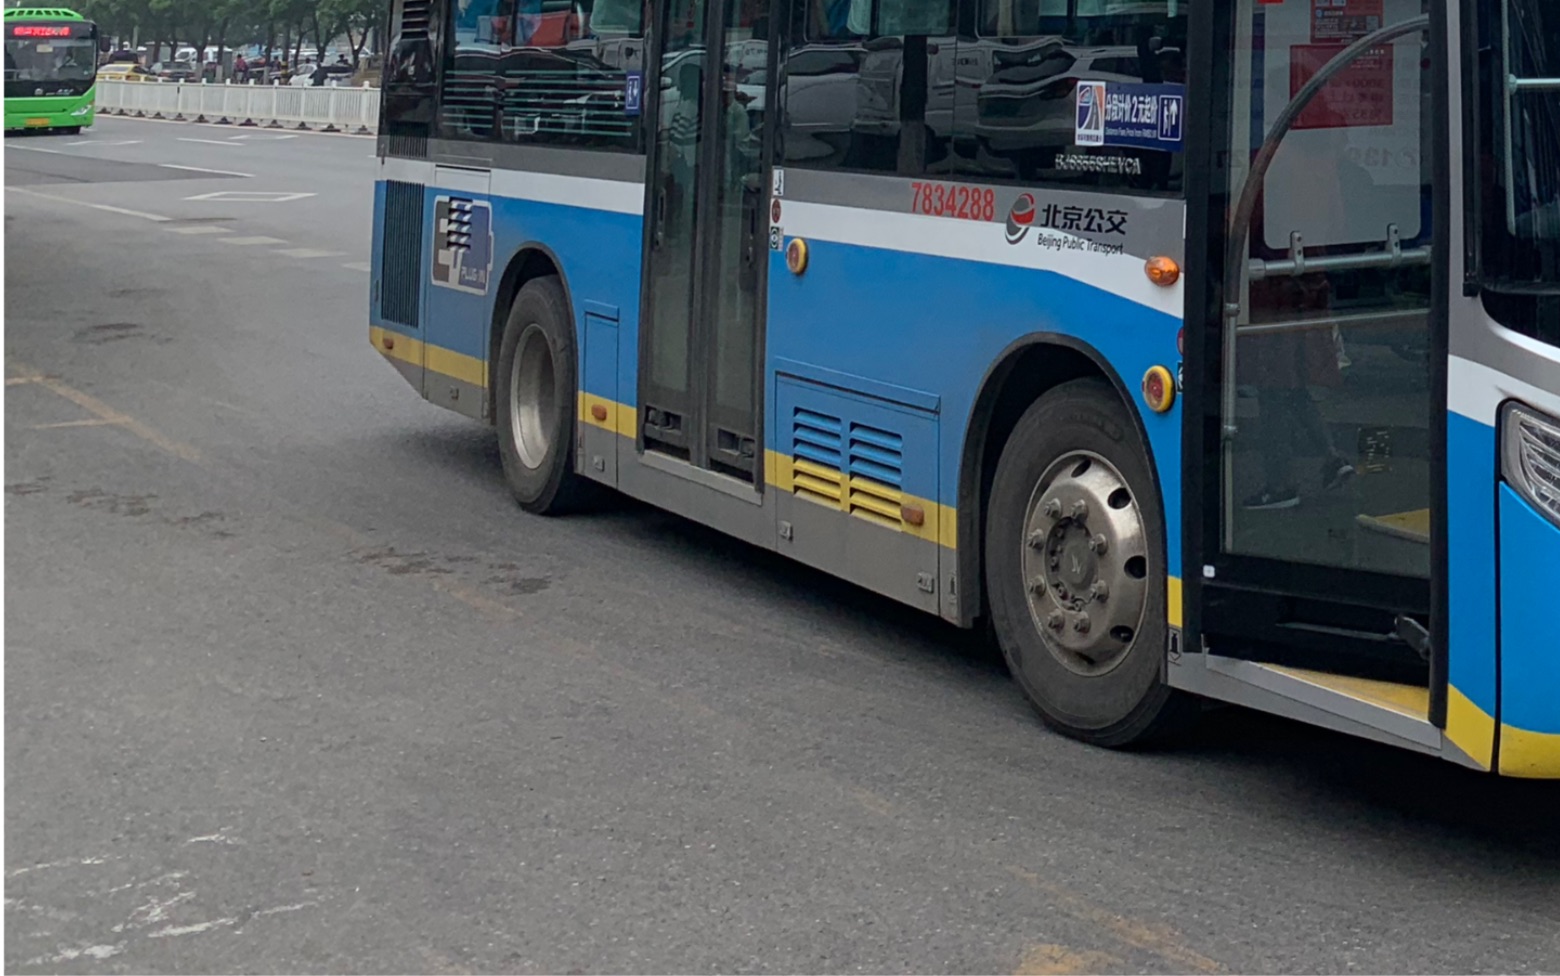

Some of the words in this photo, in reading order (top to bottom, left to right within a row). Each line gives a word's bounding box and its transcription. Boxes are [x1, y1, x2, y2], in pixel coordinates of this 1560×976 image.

[911, 182, 995, 222] 7834288
[1040, 202, 1129, 236] 北京公交
[1037, 233, 1061, 251] Beijing
[1062, 235, 1085, 251] Public
[1086, 238, 1124, 256] Transport
